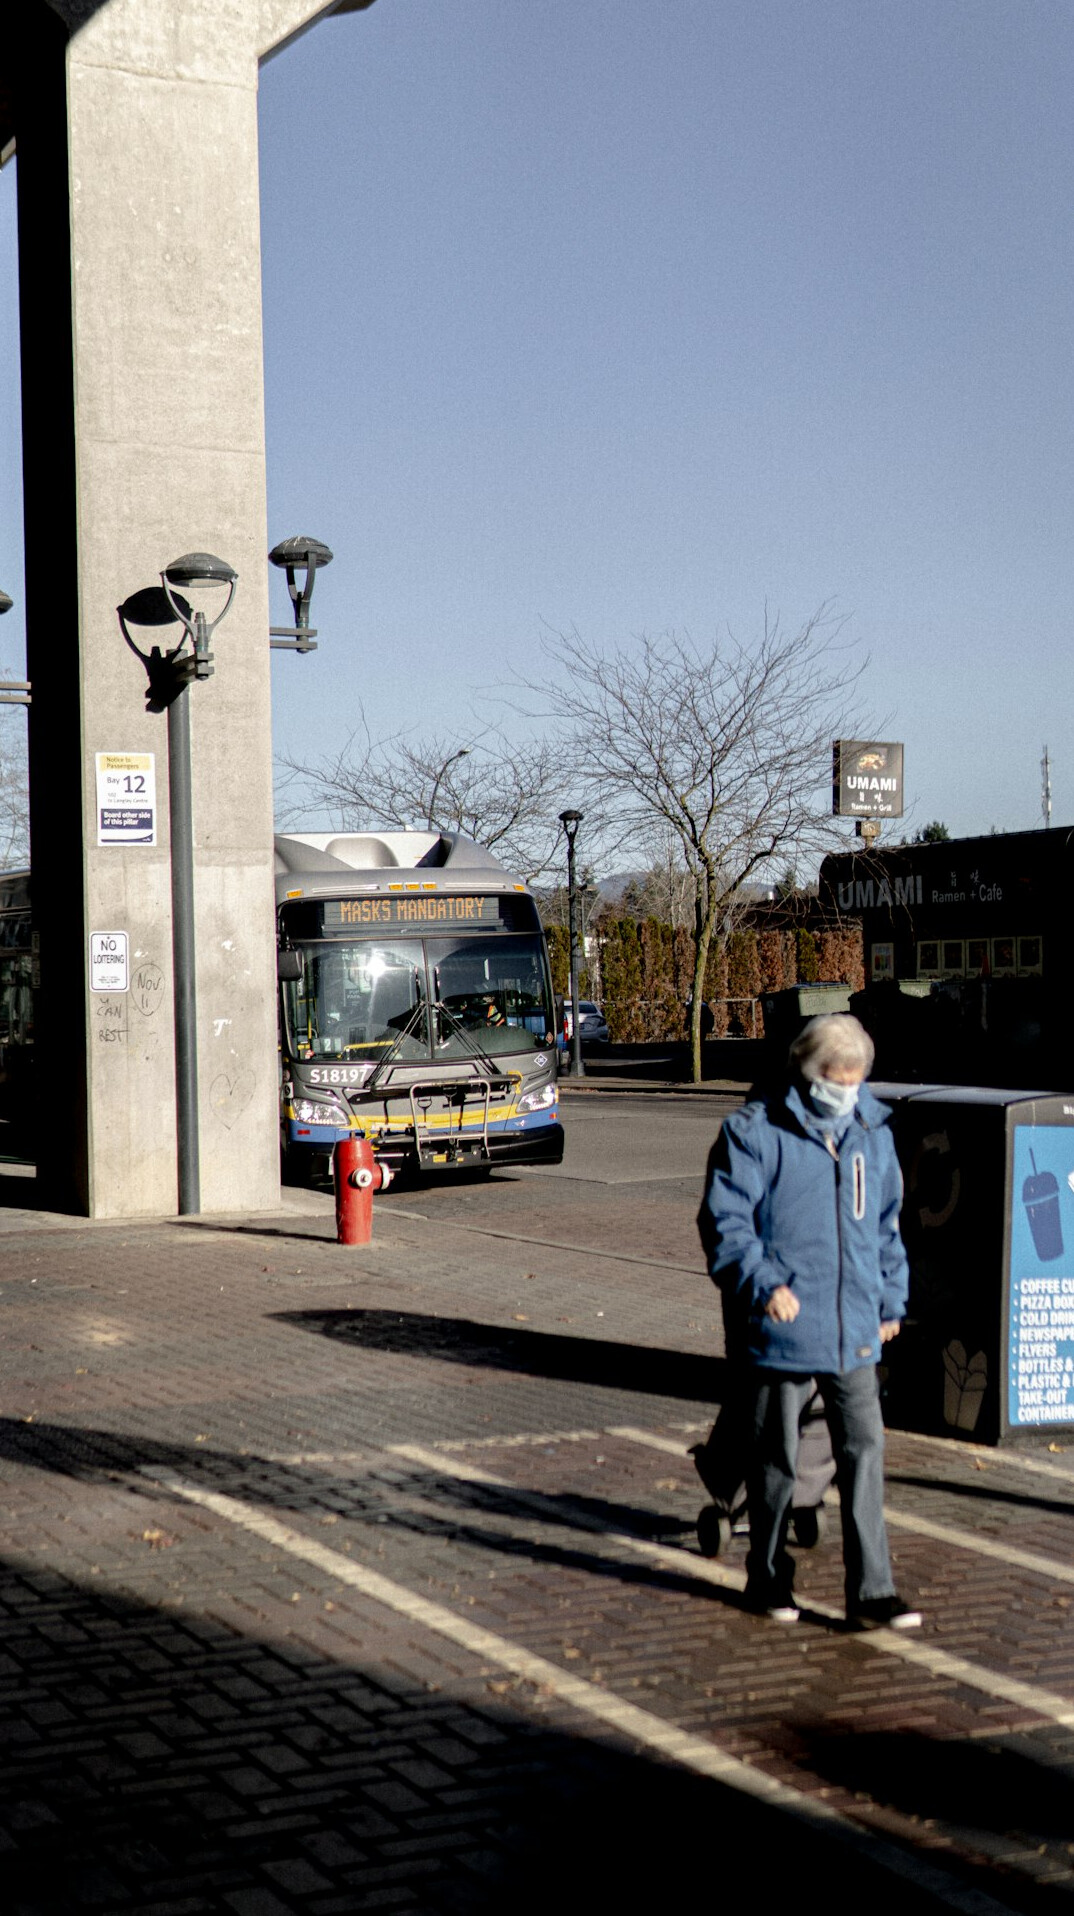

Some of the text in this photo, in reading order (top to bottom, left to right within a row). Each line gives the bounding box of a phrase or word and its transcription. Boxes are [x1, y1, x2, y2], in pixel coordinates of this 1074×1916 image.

[123, 775, 146, 793] 12
[847, 776, 897, 791] UMAMI
[838, 875, 923, 910] UMAMI
[932, 890, 966, 903] Ramen
[979, 883, 1003, 902] Cafe
[340, 897, 485, 923] MASKS MANDATORY
[101, 940, 117, 951] NO
[94, 955, 125, 964] LOITERING
[98, 1029, 128, 1042] REST
[310, 1069, 368, 1083] S18197
[1020, 1278, 1060, 1294] COFFEE
[1020, 1295, 1051, 1310] PIZZA
[1020, 1311, 1049, 1326] COLD
[1019, 1343, 1057, 1358] FLYERS
[1019, 1357, 1073, 1374] BOTTLES &
[1018, 1373, 1071, 1389] PLASTIC &
[1018, 1389, 1067, 1406] TAKE-OUT
